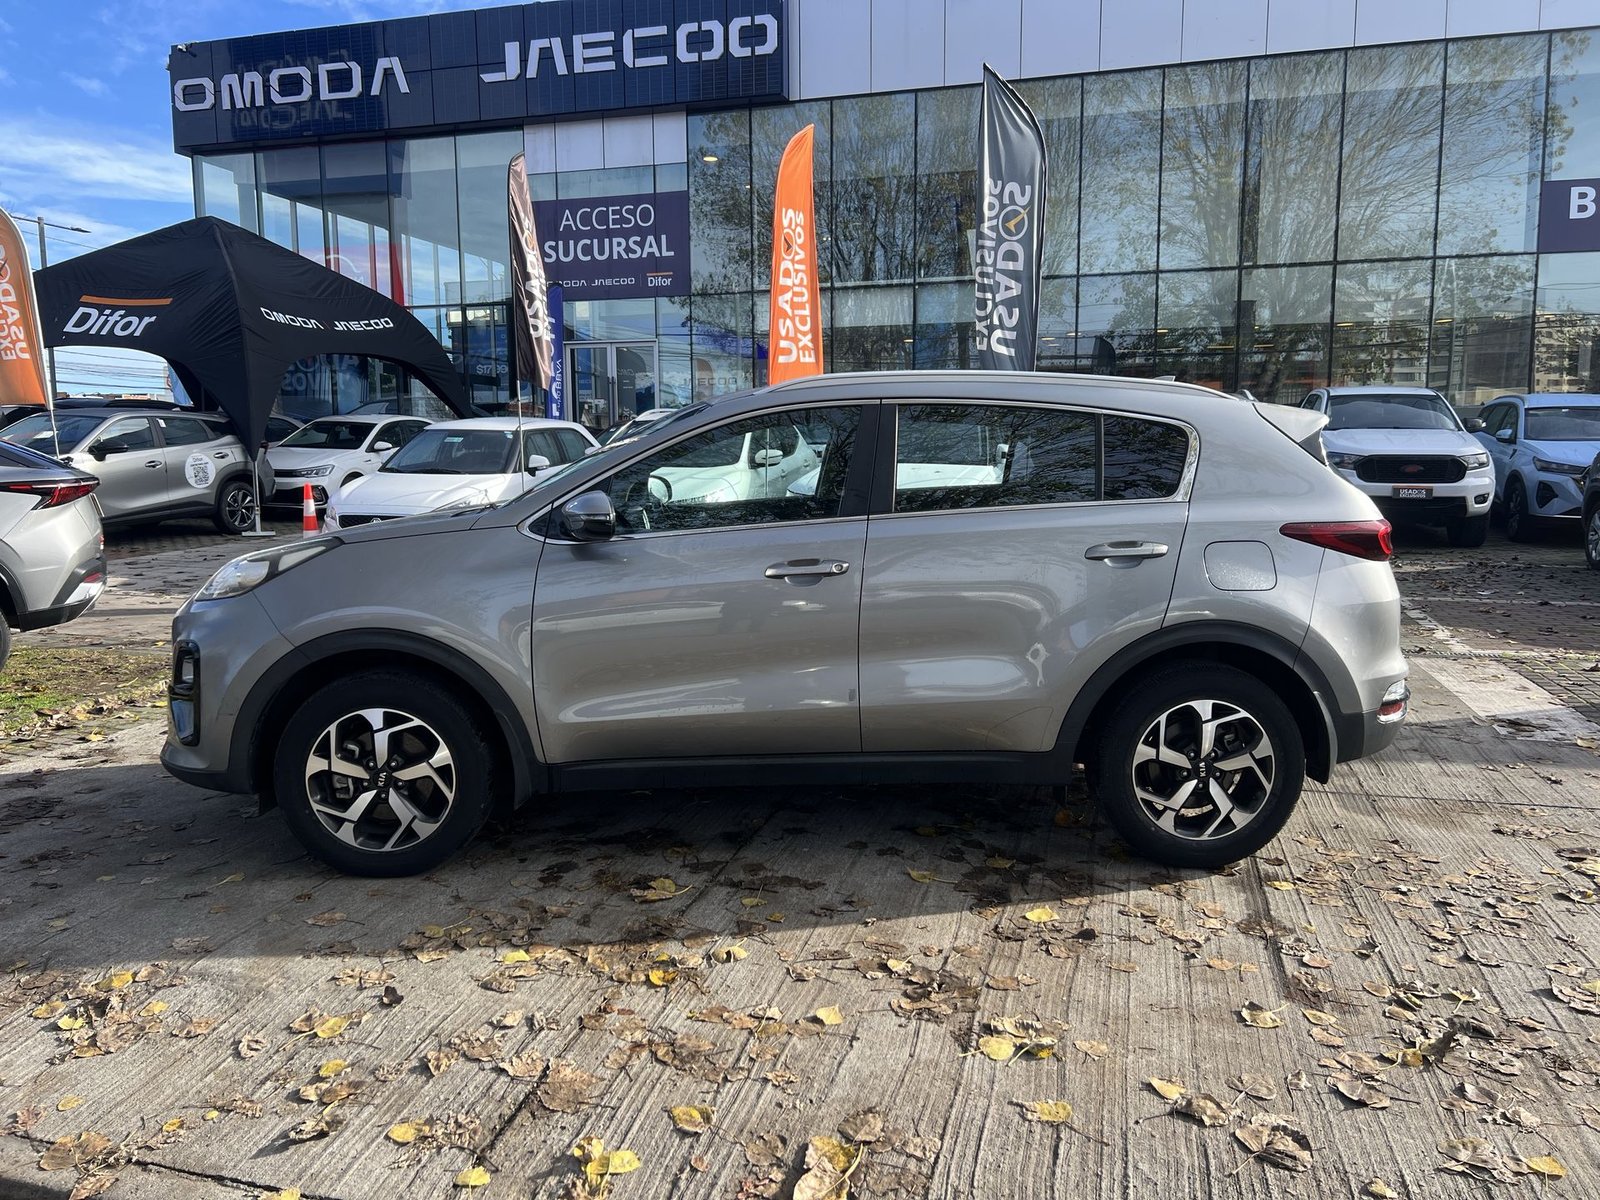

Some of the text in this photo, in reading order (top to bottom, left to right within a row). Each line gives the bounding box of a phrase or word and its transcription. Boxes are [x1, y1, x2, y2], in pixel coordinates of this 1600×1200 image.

[174, 13, 778, 112] OMODA JAECOO
[559, 203, 655, 232] ACCESO
[543, 234, 675, 263] SUCURSAL
[591, 277, 636, 286] JAECOO
[647, 275, 673, 287] Difor
[777, 207, 798, 363] USADOS
[793, 210, 816, 363] EXCLUSIVOS
[62, 306, 158, 338] Difor
[260, 307, 395, 333] OMODA JAECOO
